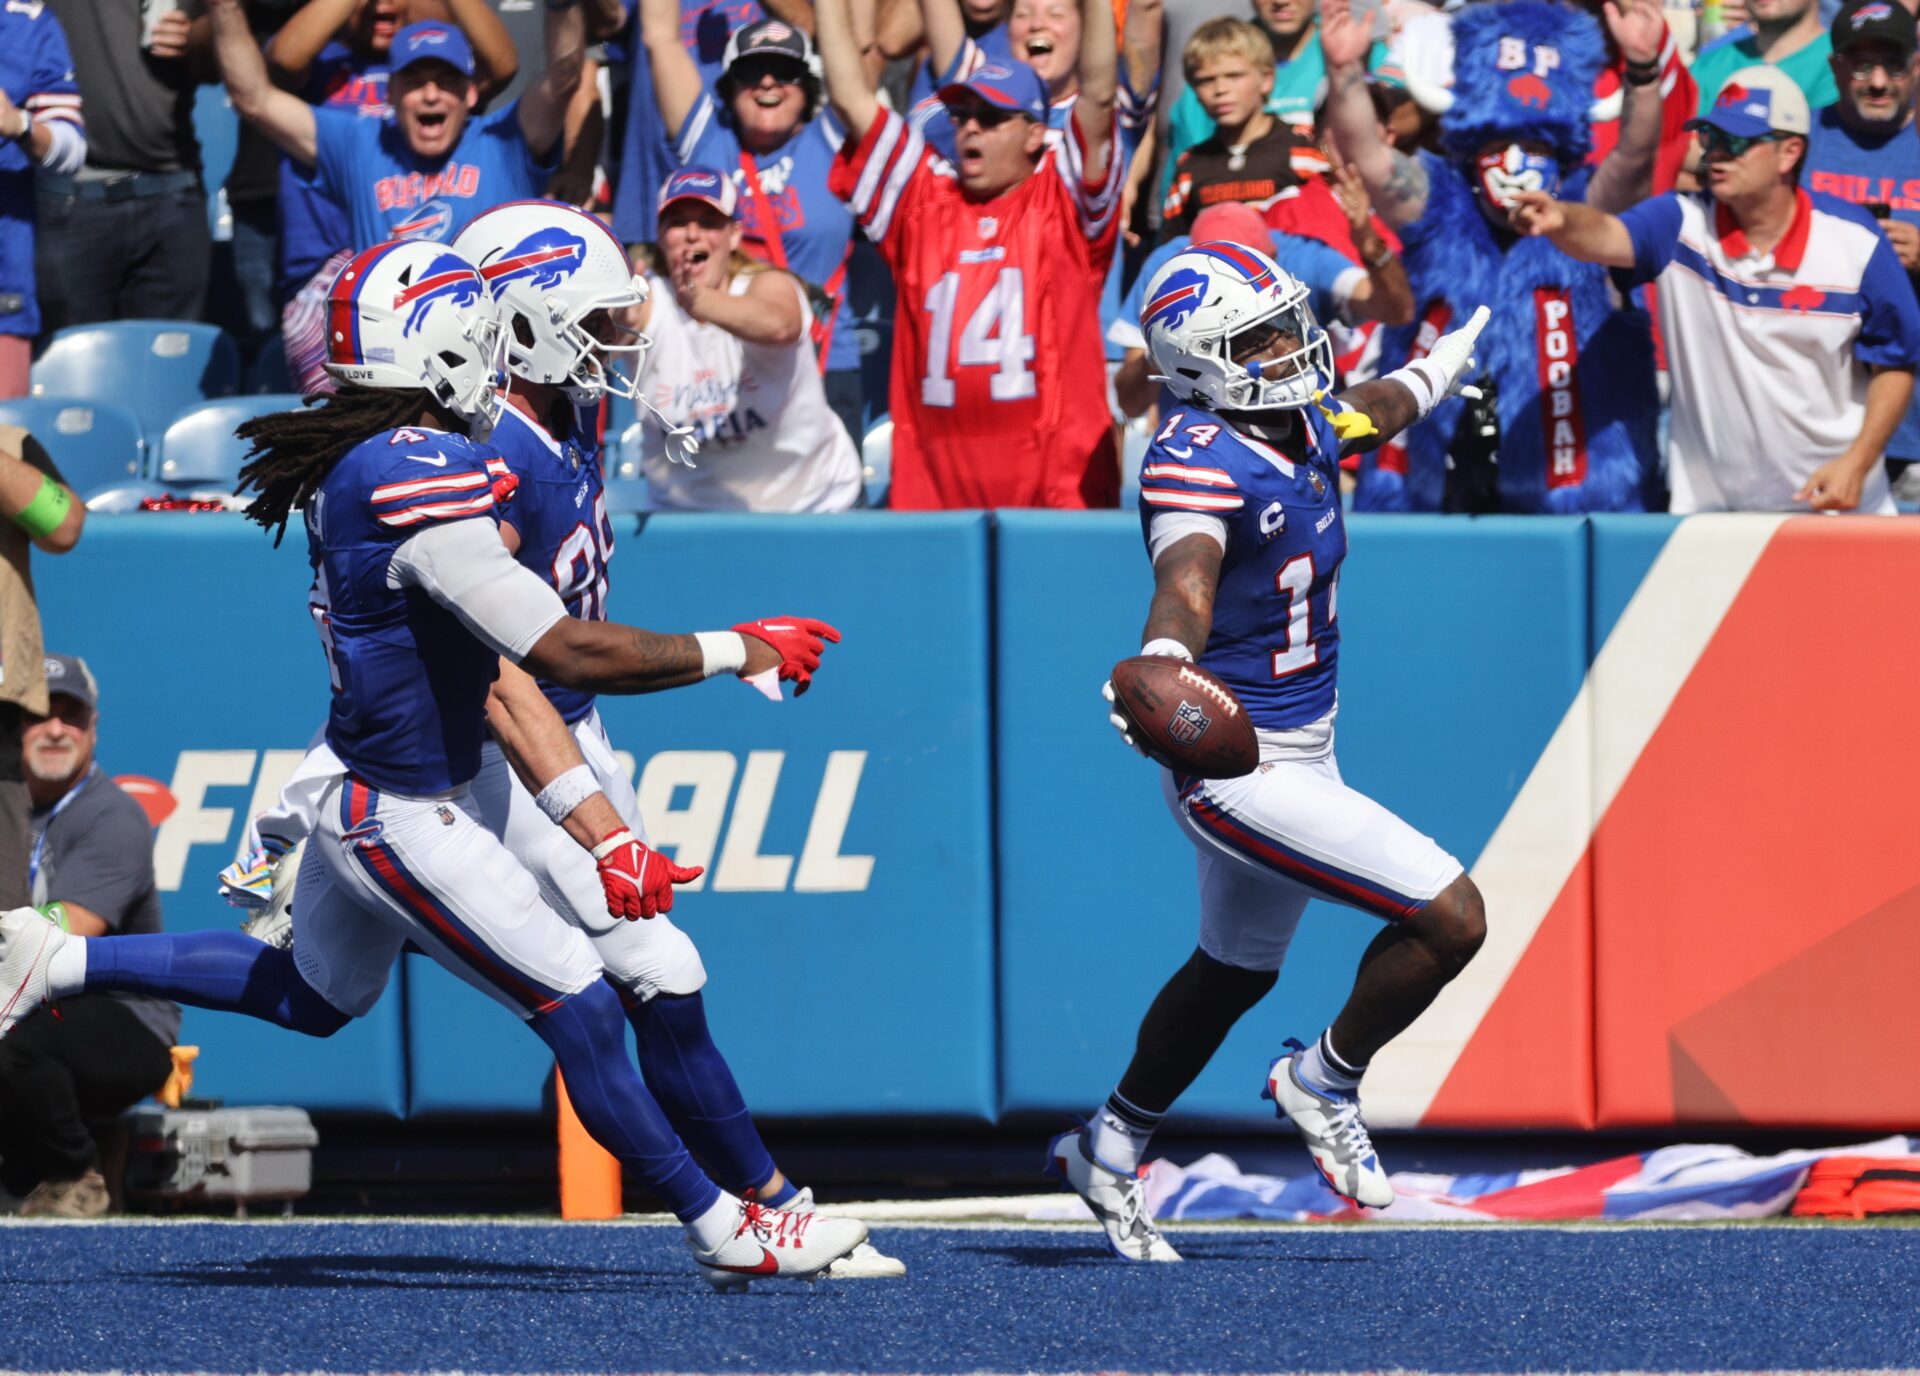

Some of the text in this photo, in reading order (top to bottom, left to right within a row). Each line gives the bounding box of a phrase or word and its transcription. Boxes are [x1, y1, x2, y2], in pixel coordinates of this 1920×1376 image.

[922, 266, 1037, 408] 14
[348, 370, 374, 380] LOVE
[1543, 299, 1576, 475] POOBAH
[388, 428, 428, 446] 4
[1156, 413, 1222, 448] 14
[1259, 501, 1286, 535] C
[1315, 507, 1336, 534] BILLS
[1171, 716, 1200, 741] NFL
